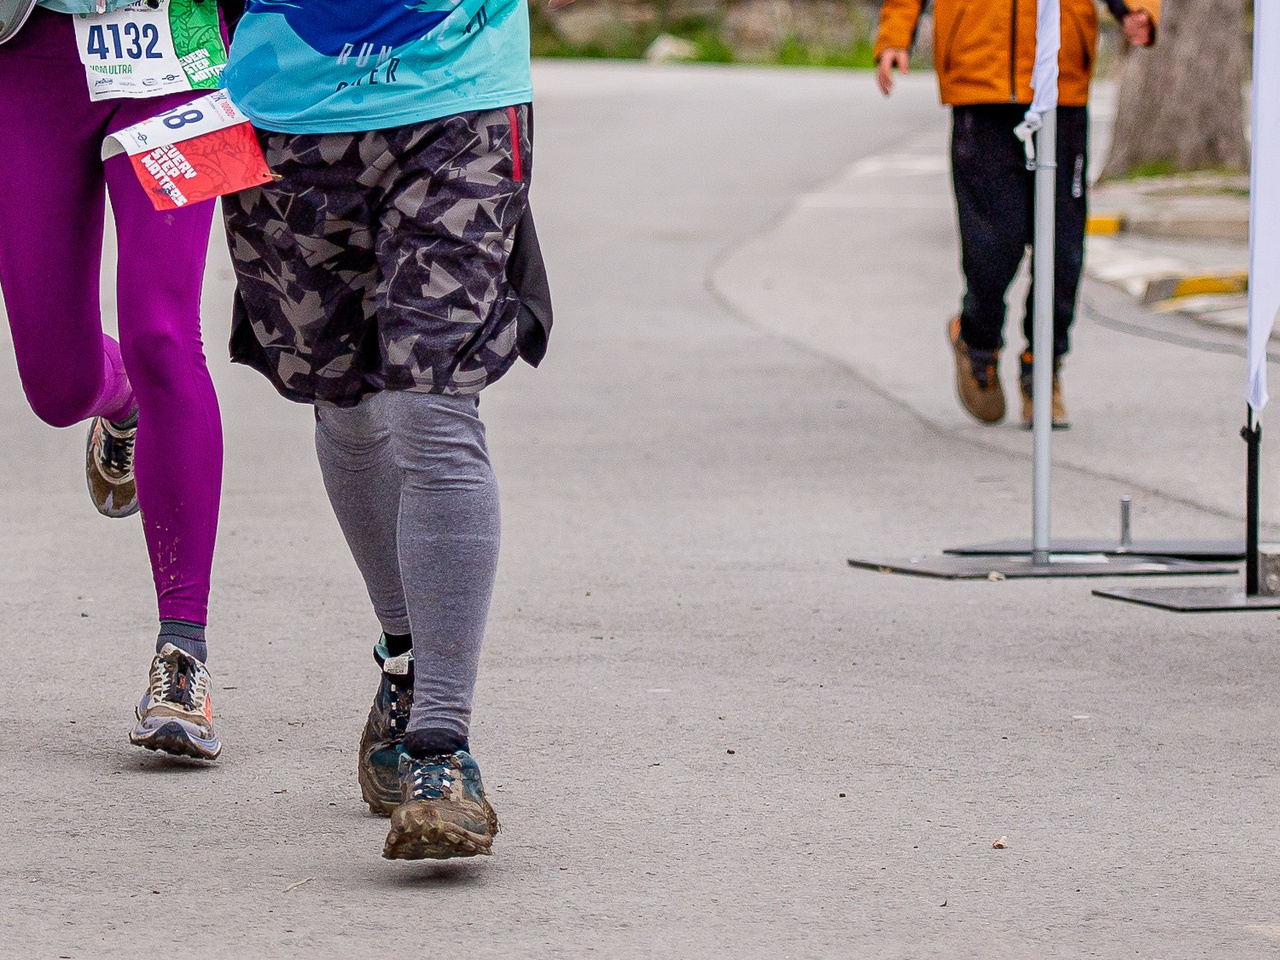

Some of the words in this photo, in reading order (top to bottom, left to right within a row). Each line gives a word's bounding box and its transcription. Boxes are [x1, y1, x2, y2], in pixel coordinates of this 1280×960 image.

[87, 22, 163, 60] 4132
[335, 42, 393, 68] RUN
[108, 64, 132, 75] ULTRA
[183, 57, 210, 75] STEP
[150, 147, 180, 178] STEP
[140, 154, 188, 207] MATTERS
